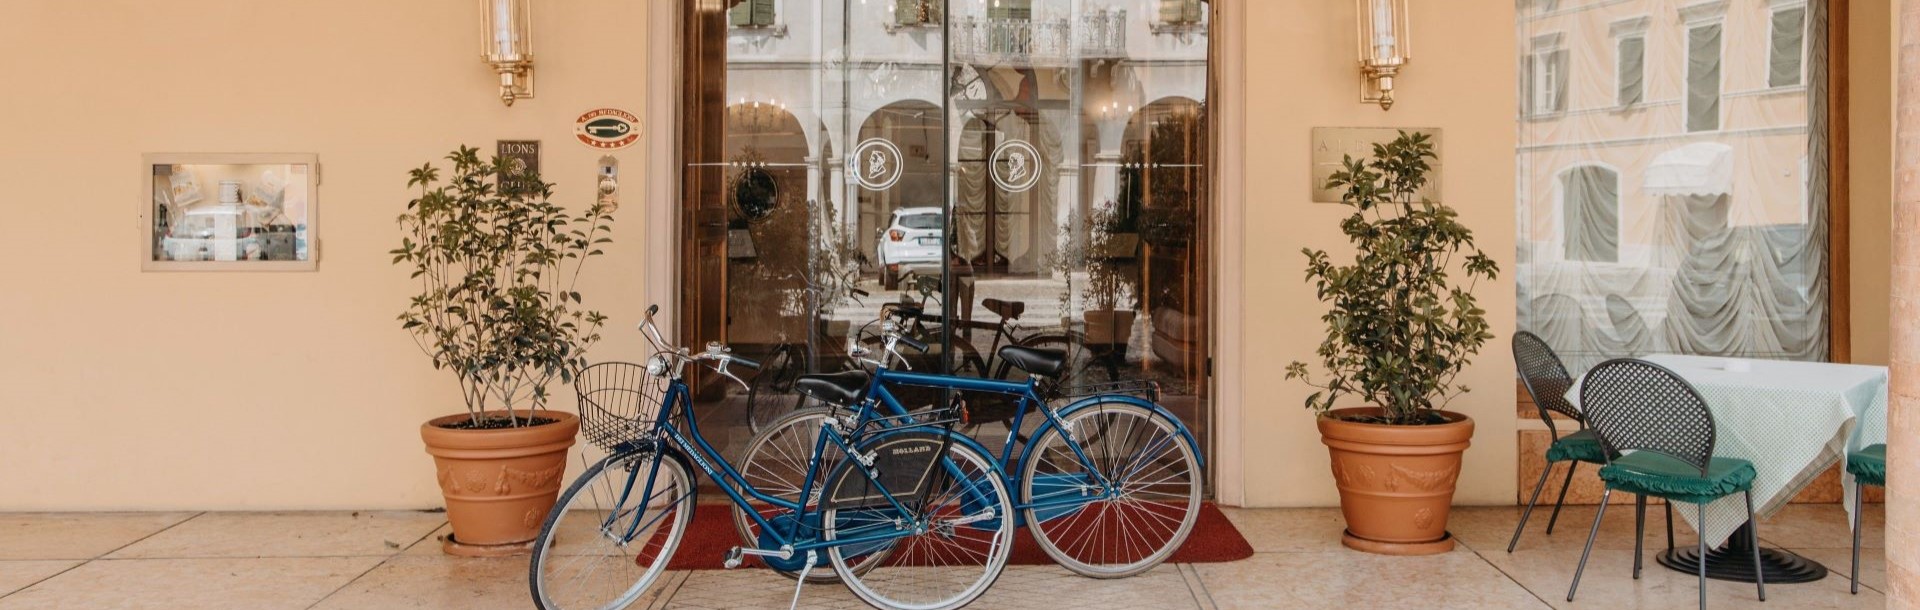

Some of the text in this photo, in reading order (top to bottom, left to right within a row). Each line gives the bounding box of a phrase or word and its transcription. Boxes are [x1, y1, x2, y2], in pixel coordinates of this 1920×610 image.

[502, 143, 535, 154] LIONS
[892, 445, 931, 455] HOLLAND
[682, 442, 713, 475] MEDAGLIONI
